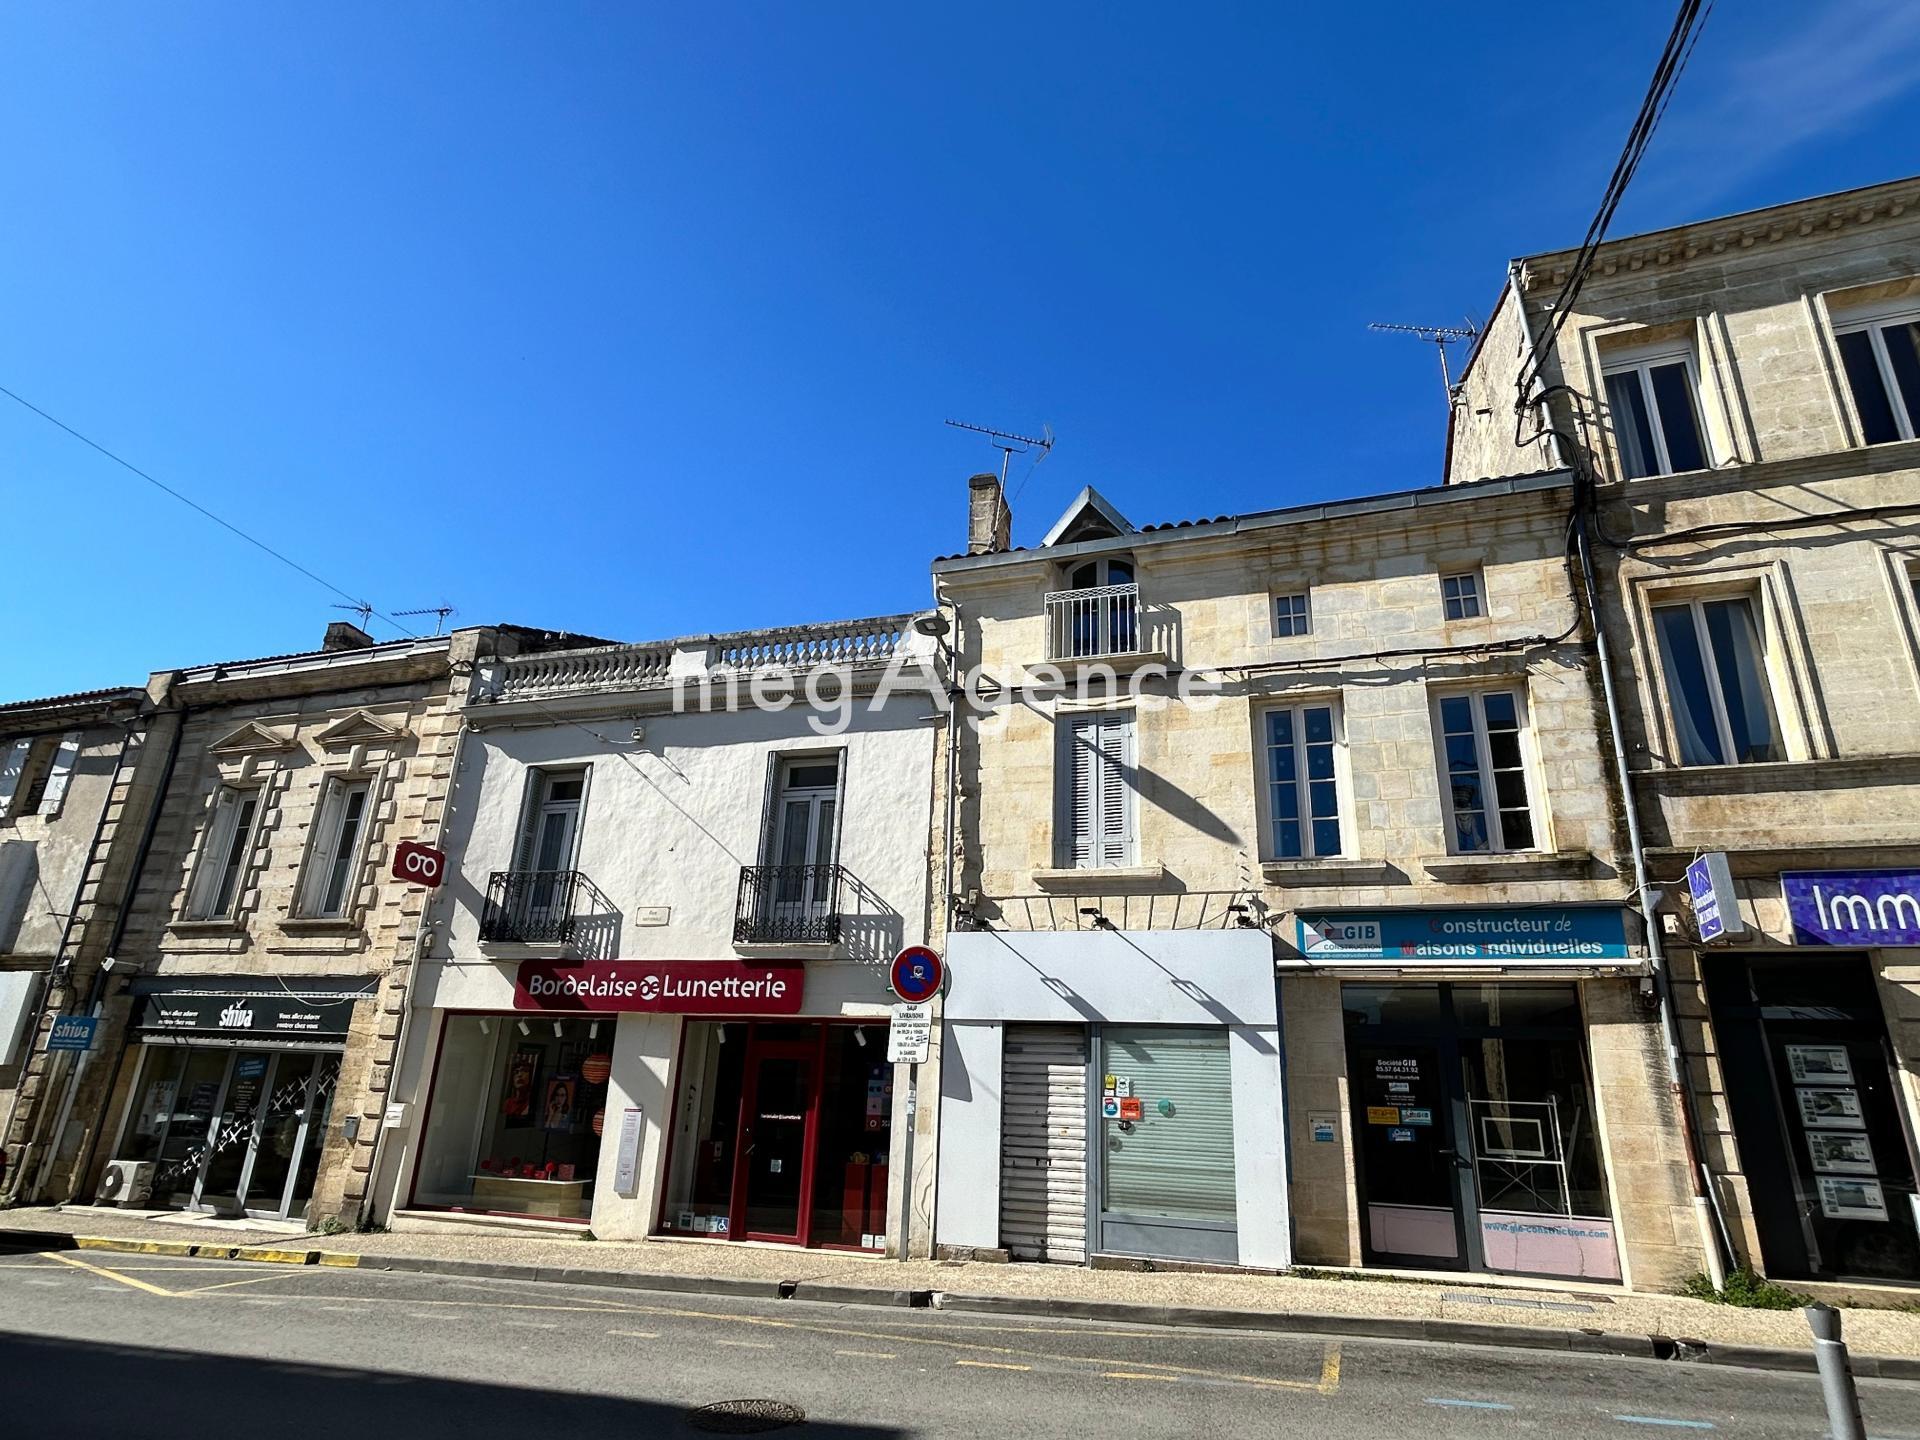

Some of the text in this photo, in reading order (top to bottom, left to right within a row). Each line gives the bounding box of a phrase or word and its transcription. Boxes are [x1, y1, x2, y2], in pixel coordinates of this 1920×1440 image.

[1429, 914, 1572, 933] Constructeur de
[1344, 925, 1376, 940] GIB
[1324, 943, 1382, 951] CONSTRUCTION
[1402, 938, 1604, 957] Maisons Individuelles
[529, 972, 786, 998] Bordelaise Lunetterie
[219, 1001, 253, 1027] shiva
[54, 1022, 90, 1038] shiva
[1403, 1059, 1417, 1067] GIB
